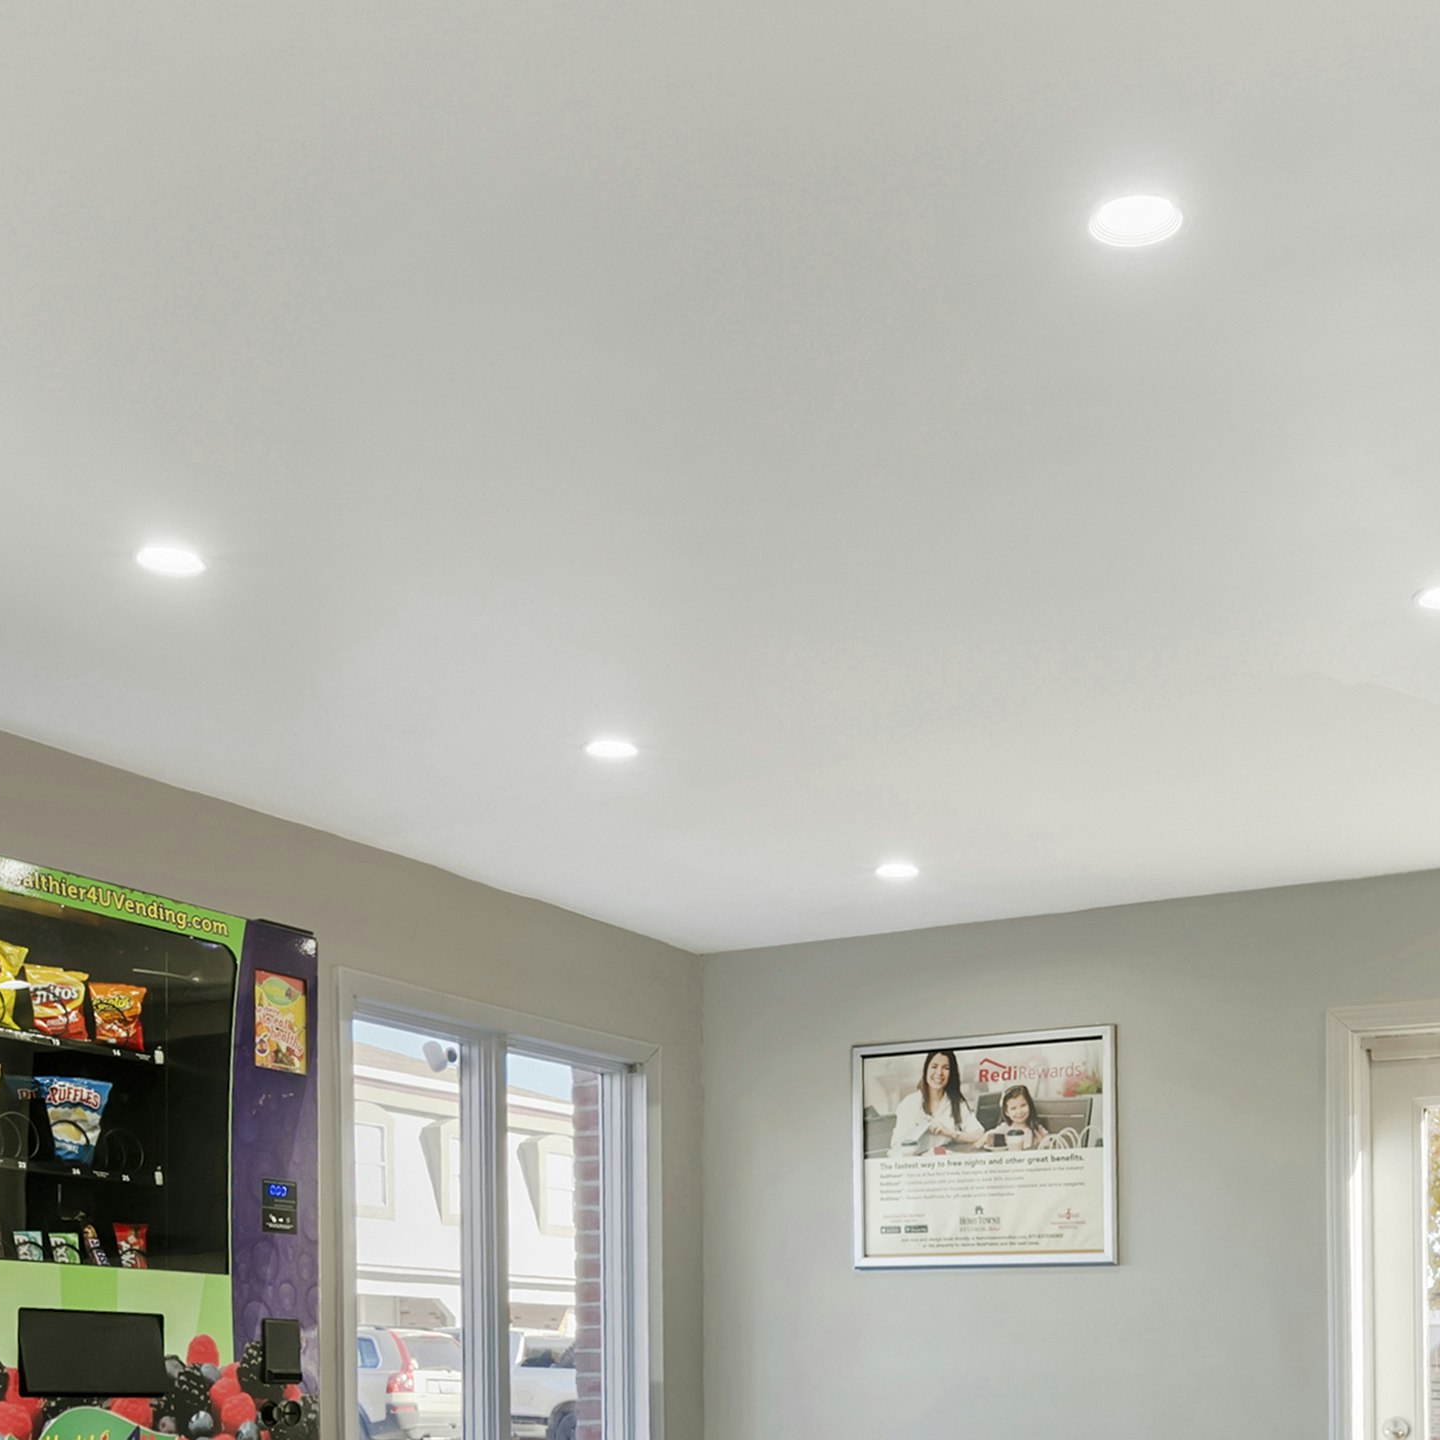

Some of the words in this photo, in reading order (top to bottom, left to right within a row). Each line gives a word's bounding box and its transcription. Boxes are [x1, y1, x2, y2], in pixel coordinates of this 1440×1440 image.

[46, 1084, 101, 1109] RUFFLES
[920, 1162, 935, 1170] way
[947, 1159, 962, 1167] free
[964, 1159, 986, 1168] nights
[988, 1157, 1003, 1165] and
[1005, 1156, 1025, 1164] other
[1027, 1156, 1048, 1165] great
[1050, 1154, 1084, 1162] benefits.
